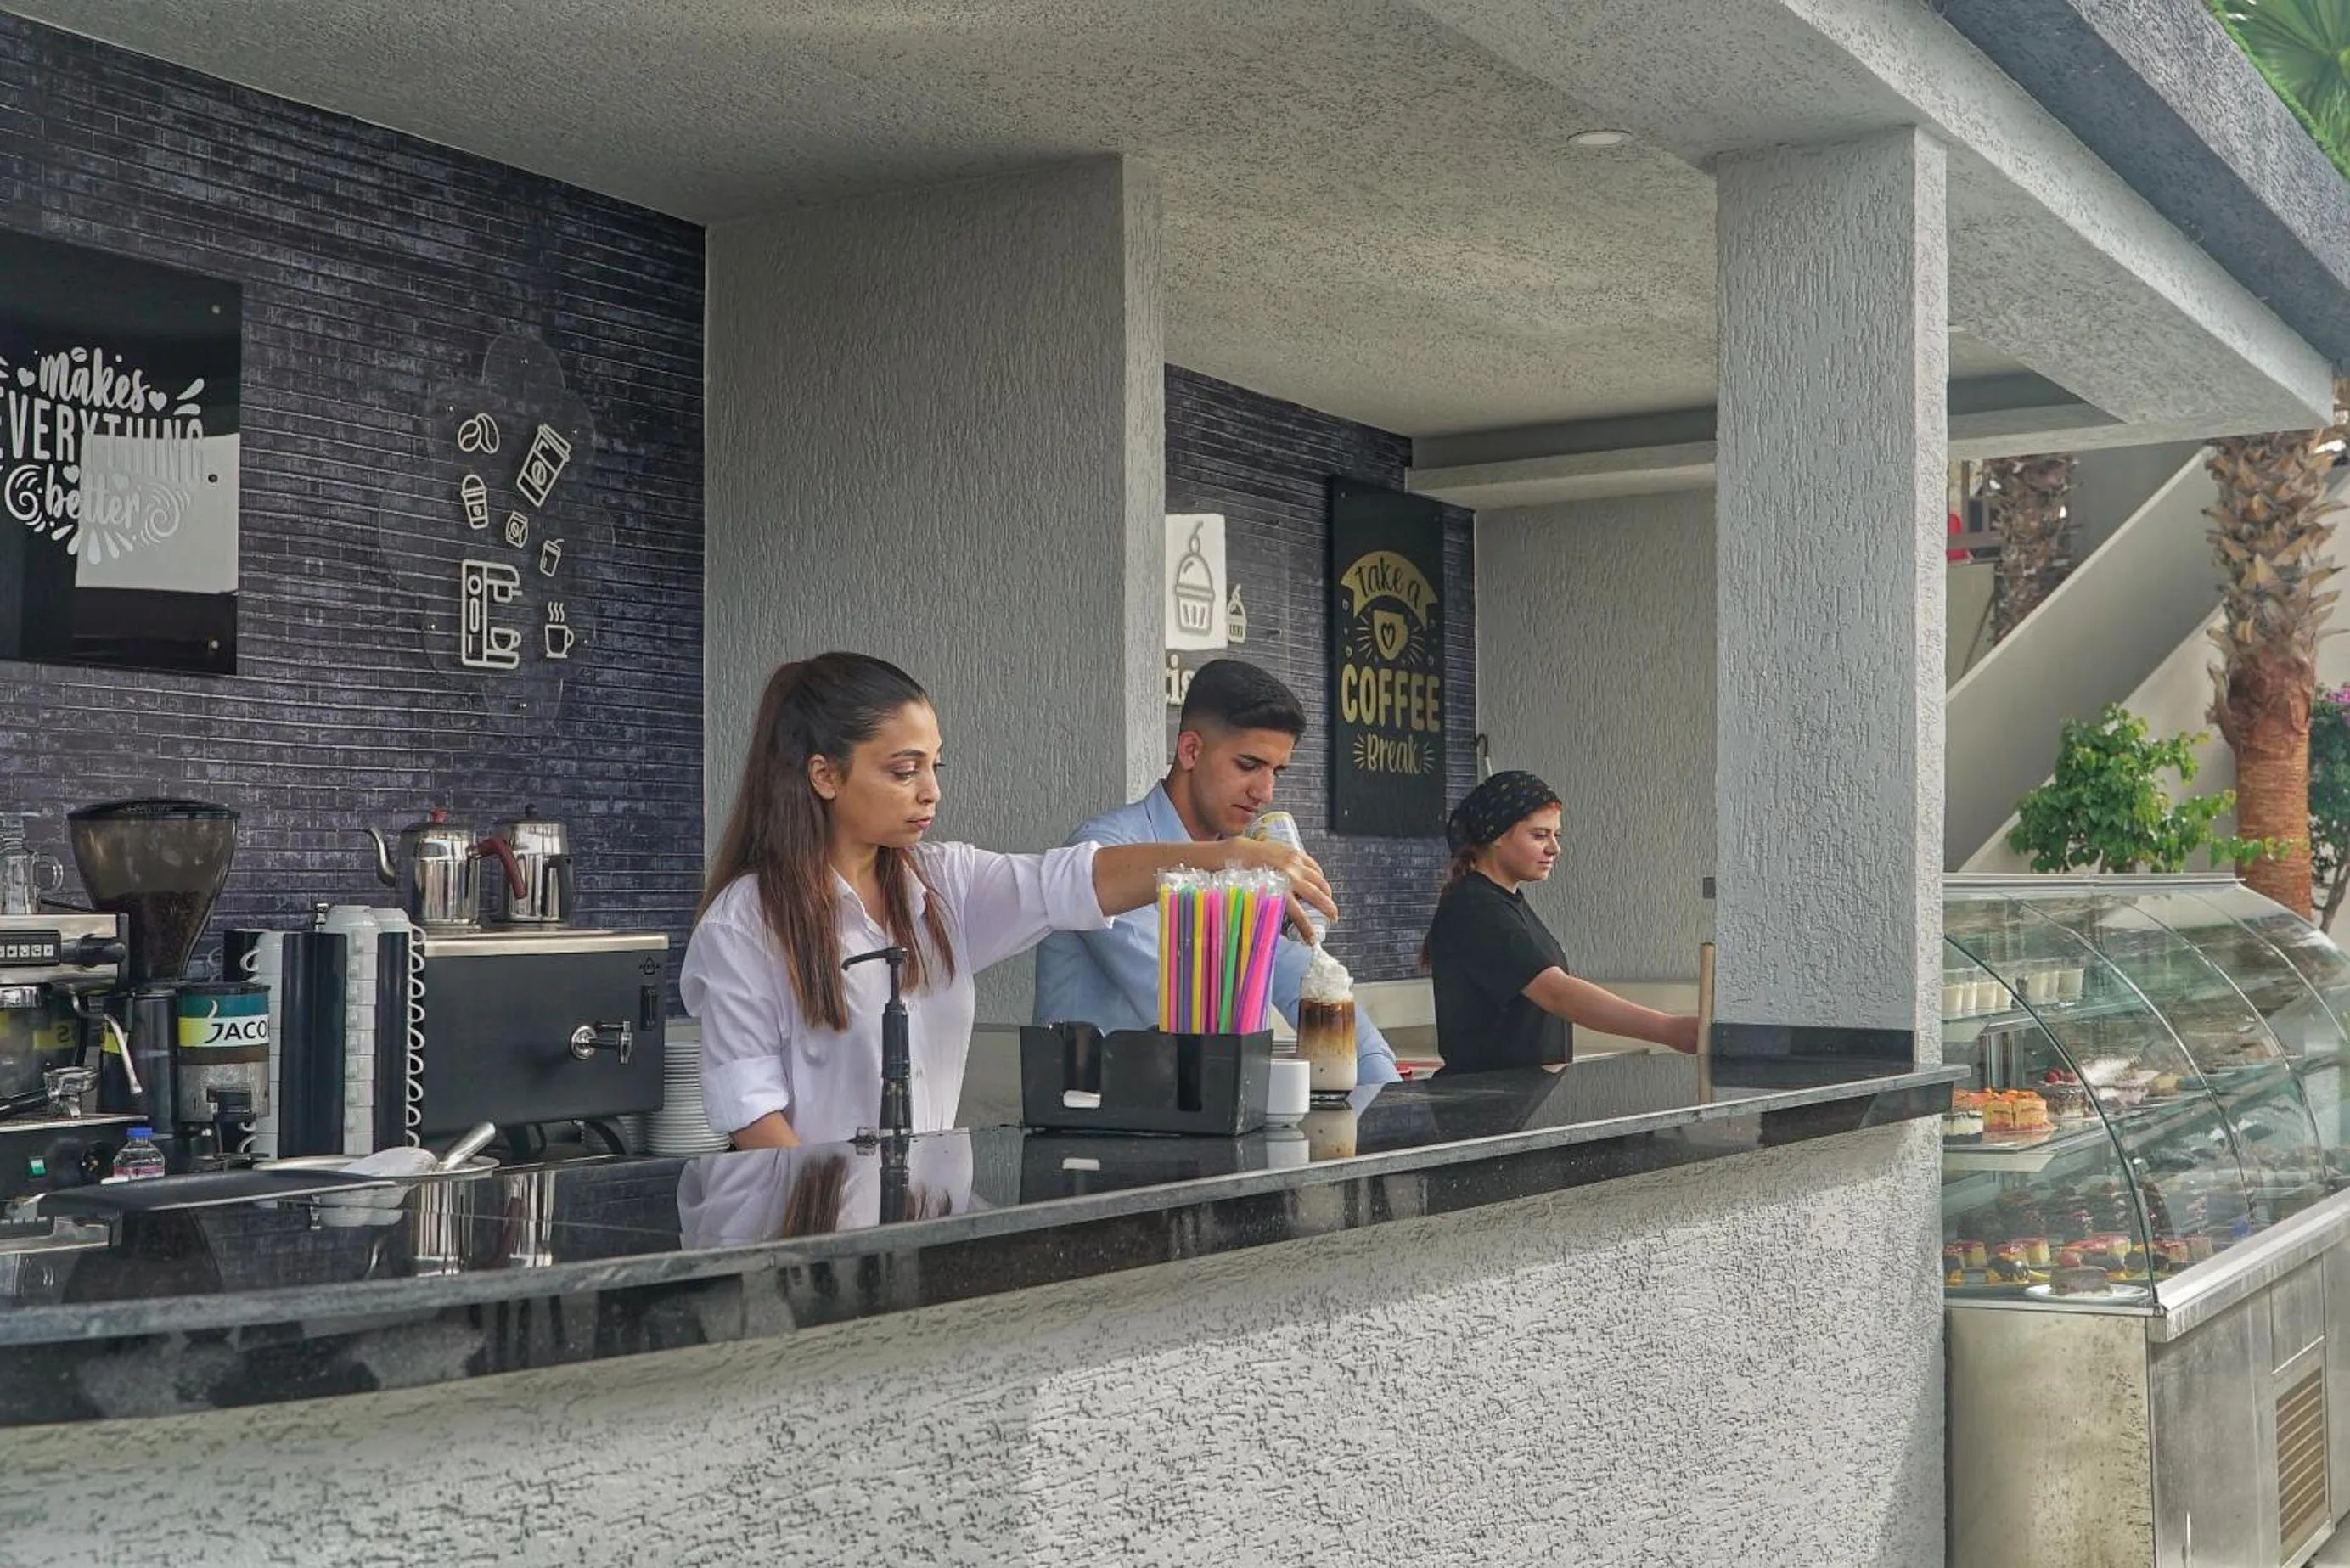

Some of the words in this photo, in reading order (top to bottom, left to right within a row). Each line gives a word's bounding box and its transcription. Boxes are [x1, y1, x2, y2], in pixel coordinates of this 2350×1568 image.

[39, 347, 150, 413] makes
[0, 386, 204, 487] VERYTHING
[45, 464, 140, 529] better
[1408, 580, 1421, 610] a
[1341, 663, 1441, 733] COFFEE
[1366, 732, 1423, 775] Break
[204, 1020, 267, 1044] JACO
